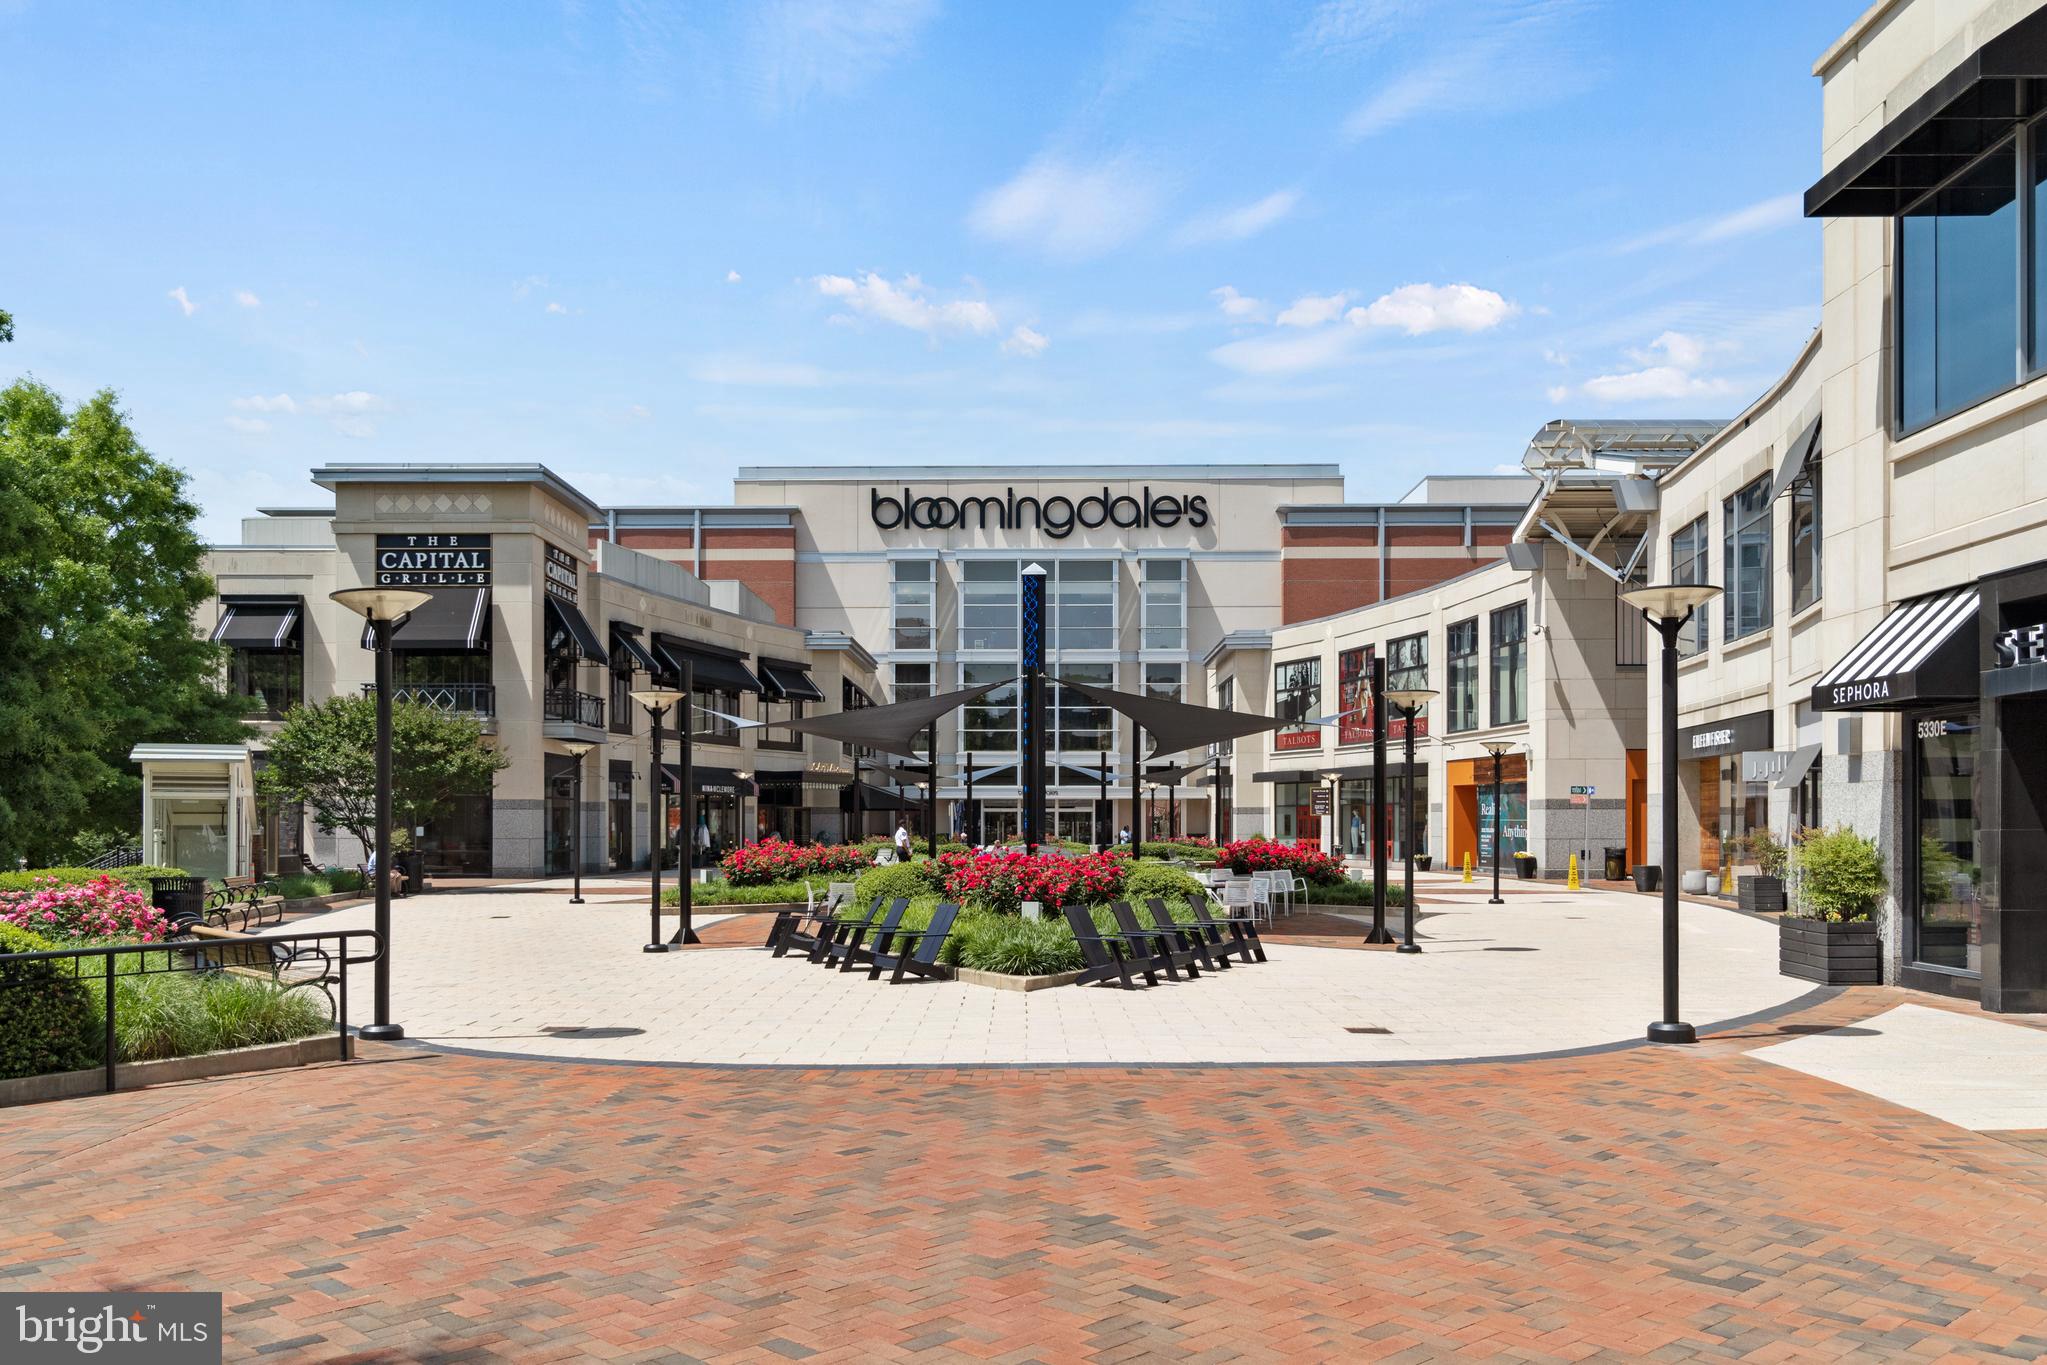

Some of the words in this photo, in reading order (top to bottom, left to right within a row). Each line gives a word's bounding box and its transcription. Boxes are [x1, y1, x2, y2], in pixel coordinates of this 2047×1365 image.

[871, 486, 1208, 539] bloomingdale's
[407, 536, 458, 547] THE
[381, 552, 485, 569] CAPITAL
[553, 549, 570, 565] THE
[546, 560, 577, 589] CAPITAL
[1833, 681, 1889, 704] SEPHORA
[1344, 728, 1374, 740] TALBOTS
[1393, 720, 1425, 733] TALTS
[1918, 720, 1948, 739] 5330E
[1282, 735, 1316, 745] TALBOTS
[1481, 802, 1501, 815] Reali
